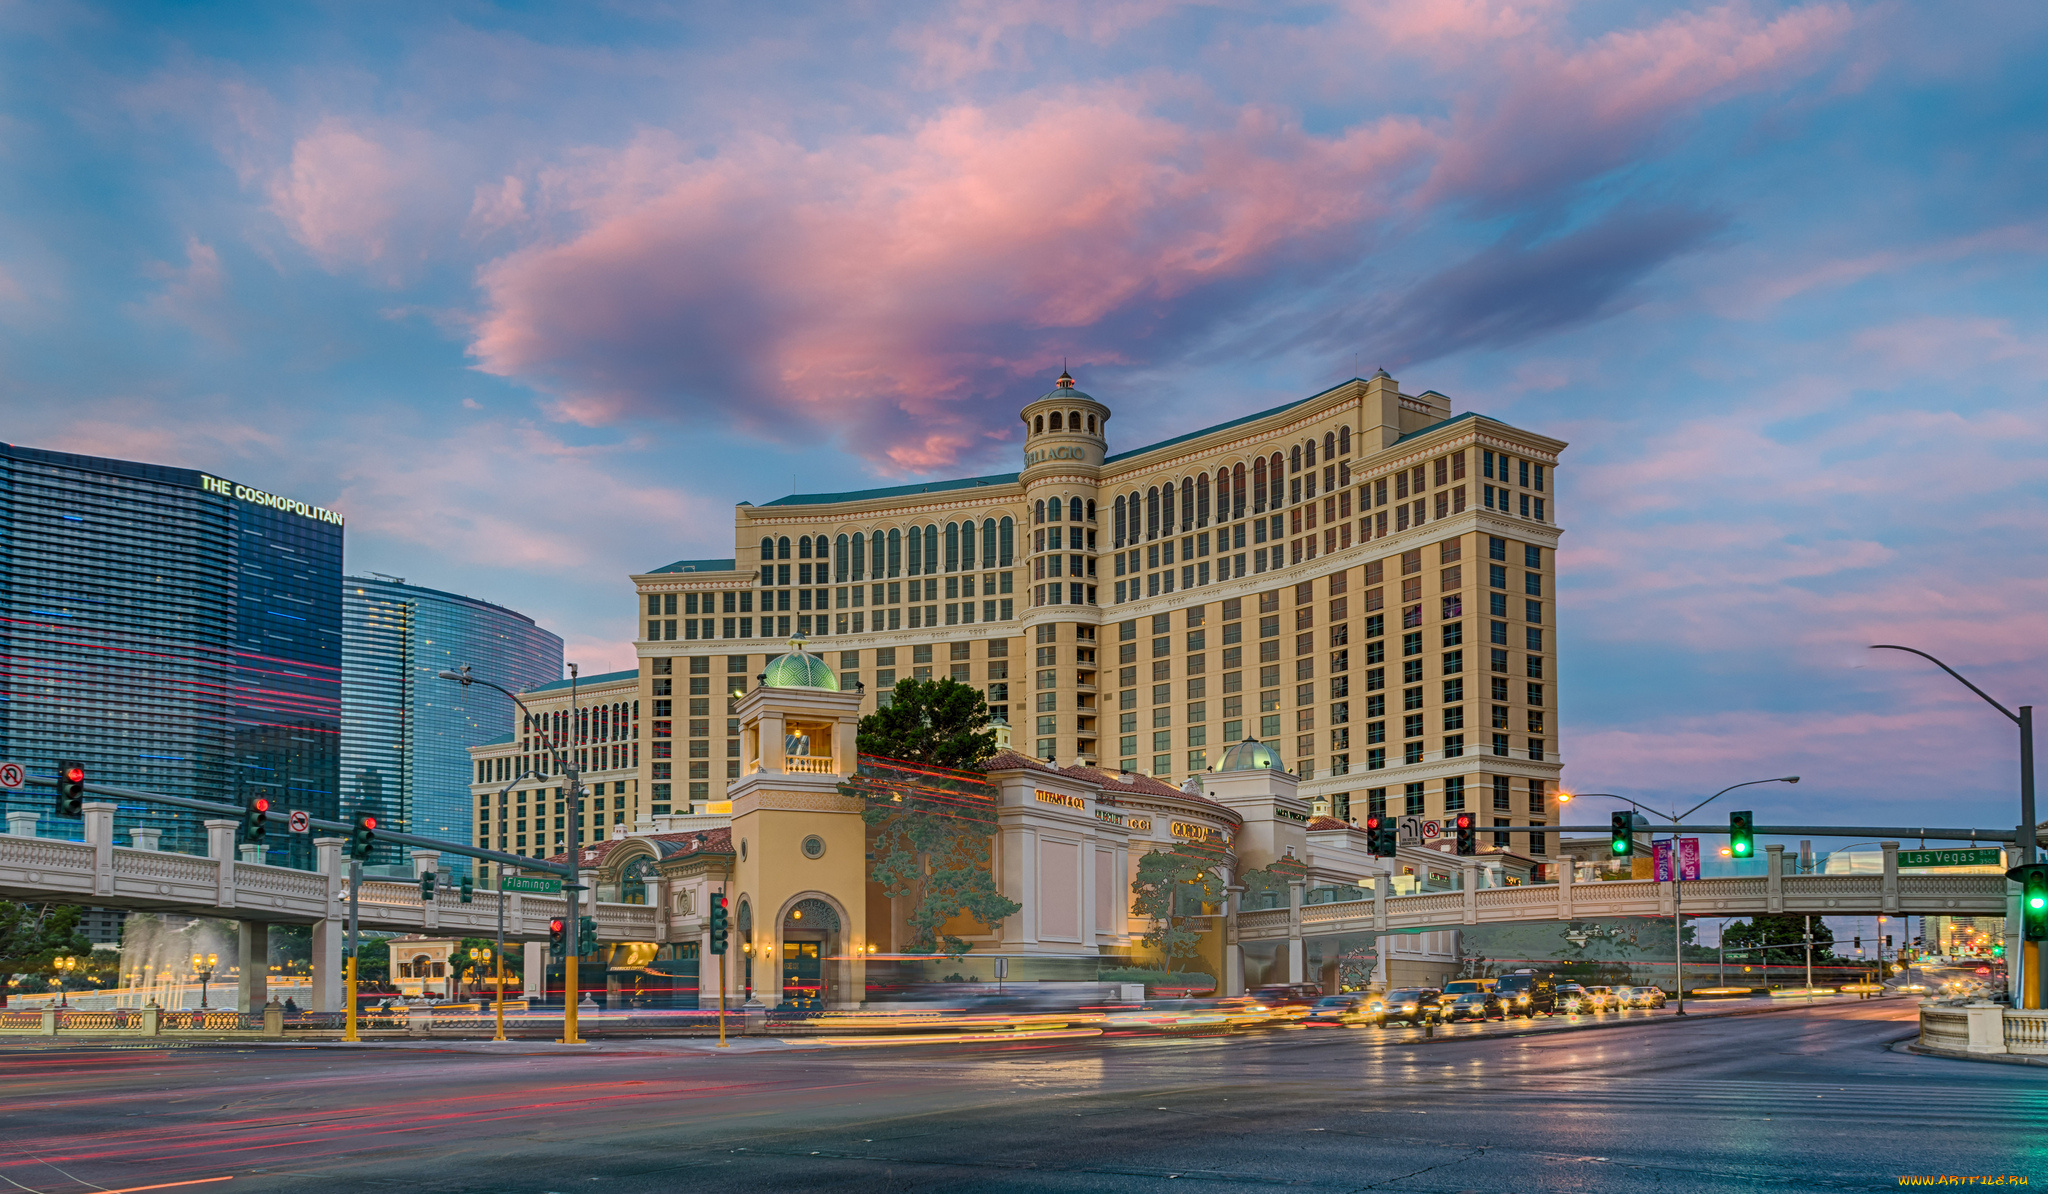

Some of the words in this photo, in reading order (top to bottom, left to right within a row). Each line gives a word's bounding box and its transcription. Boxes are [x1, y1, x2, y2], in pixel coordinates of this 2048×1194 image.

[1024, 446, 1085, 470] BELLAGIO
[201, 475, 231, 496] THE
[235, 484, 343, 526] COSMOPOLITAN
[1035, 789, 1066, 806] TIFFANY
[1658, 846, 1666, 858] LAS
[1685, 844, 1694, 866] VEGAS
[1908, 852, 1930, 863] Las
[1935, 851, 1974, 865] Vegas
[1659, 860, 1668, 880] VEGAS
[1685, 866, 1694, 879] LAS
[507, 877, 550, 891] Flamingo
